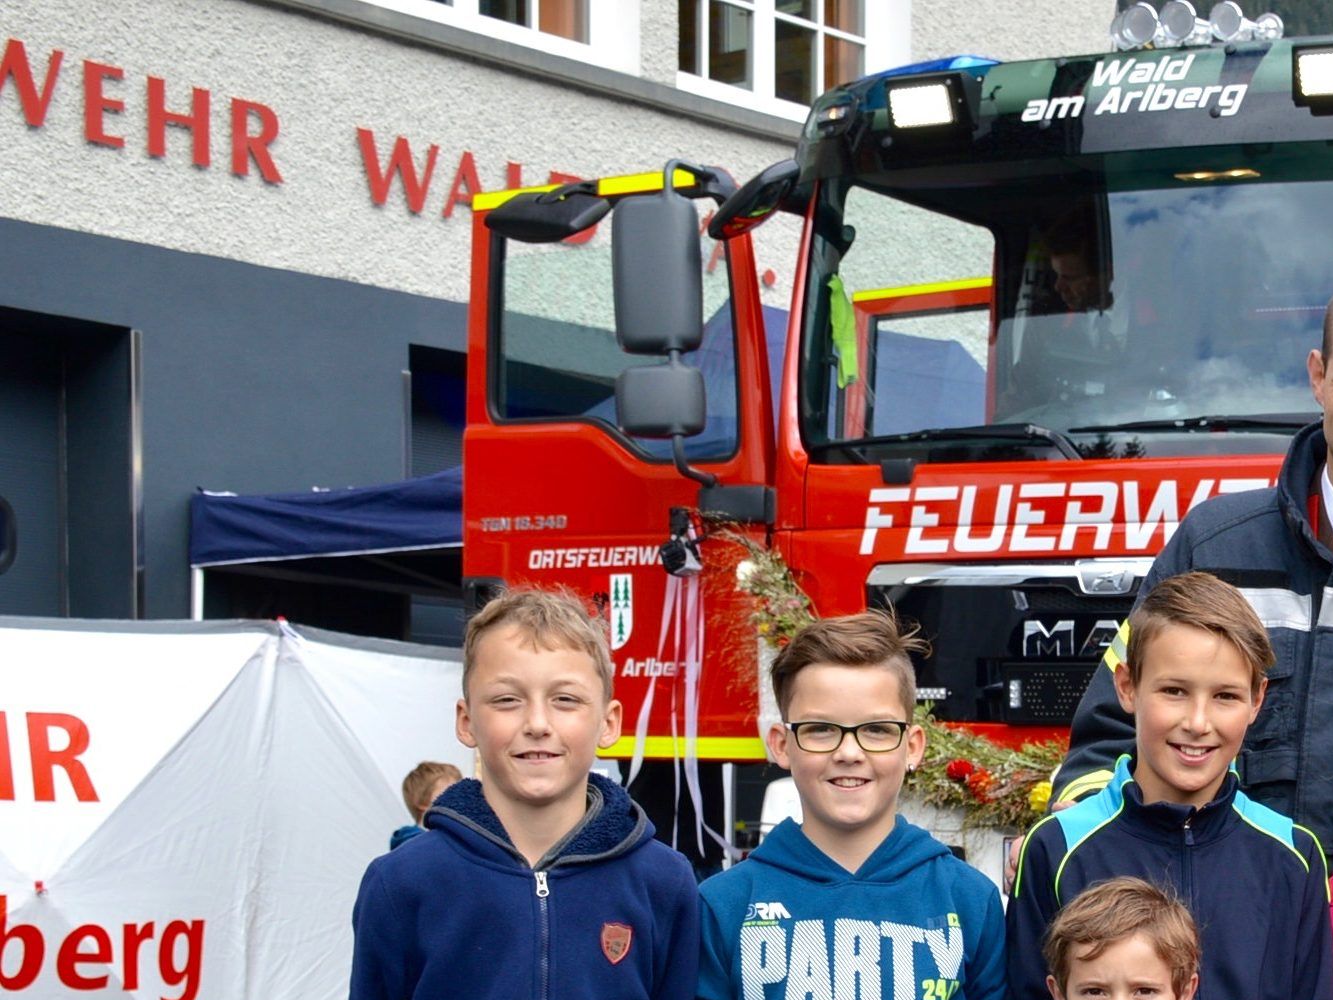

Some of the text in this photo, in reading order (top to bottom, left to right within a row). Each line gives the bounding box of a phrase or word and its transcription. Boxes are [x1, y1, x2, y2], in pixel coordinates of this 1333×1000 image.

[1092, 54, 1196, 87] Wald
[1021, 82, 1249, 122] am Arlberg
[528, 546, 664, 569] ORTSFEUERW
